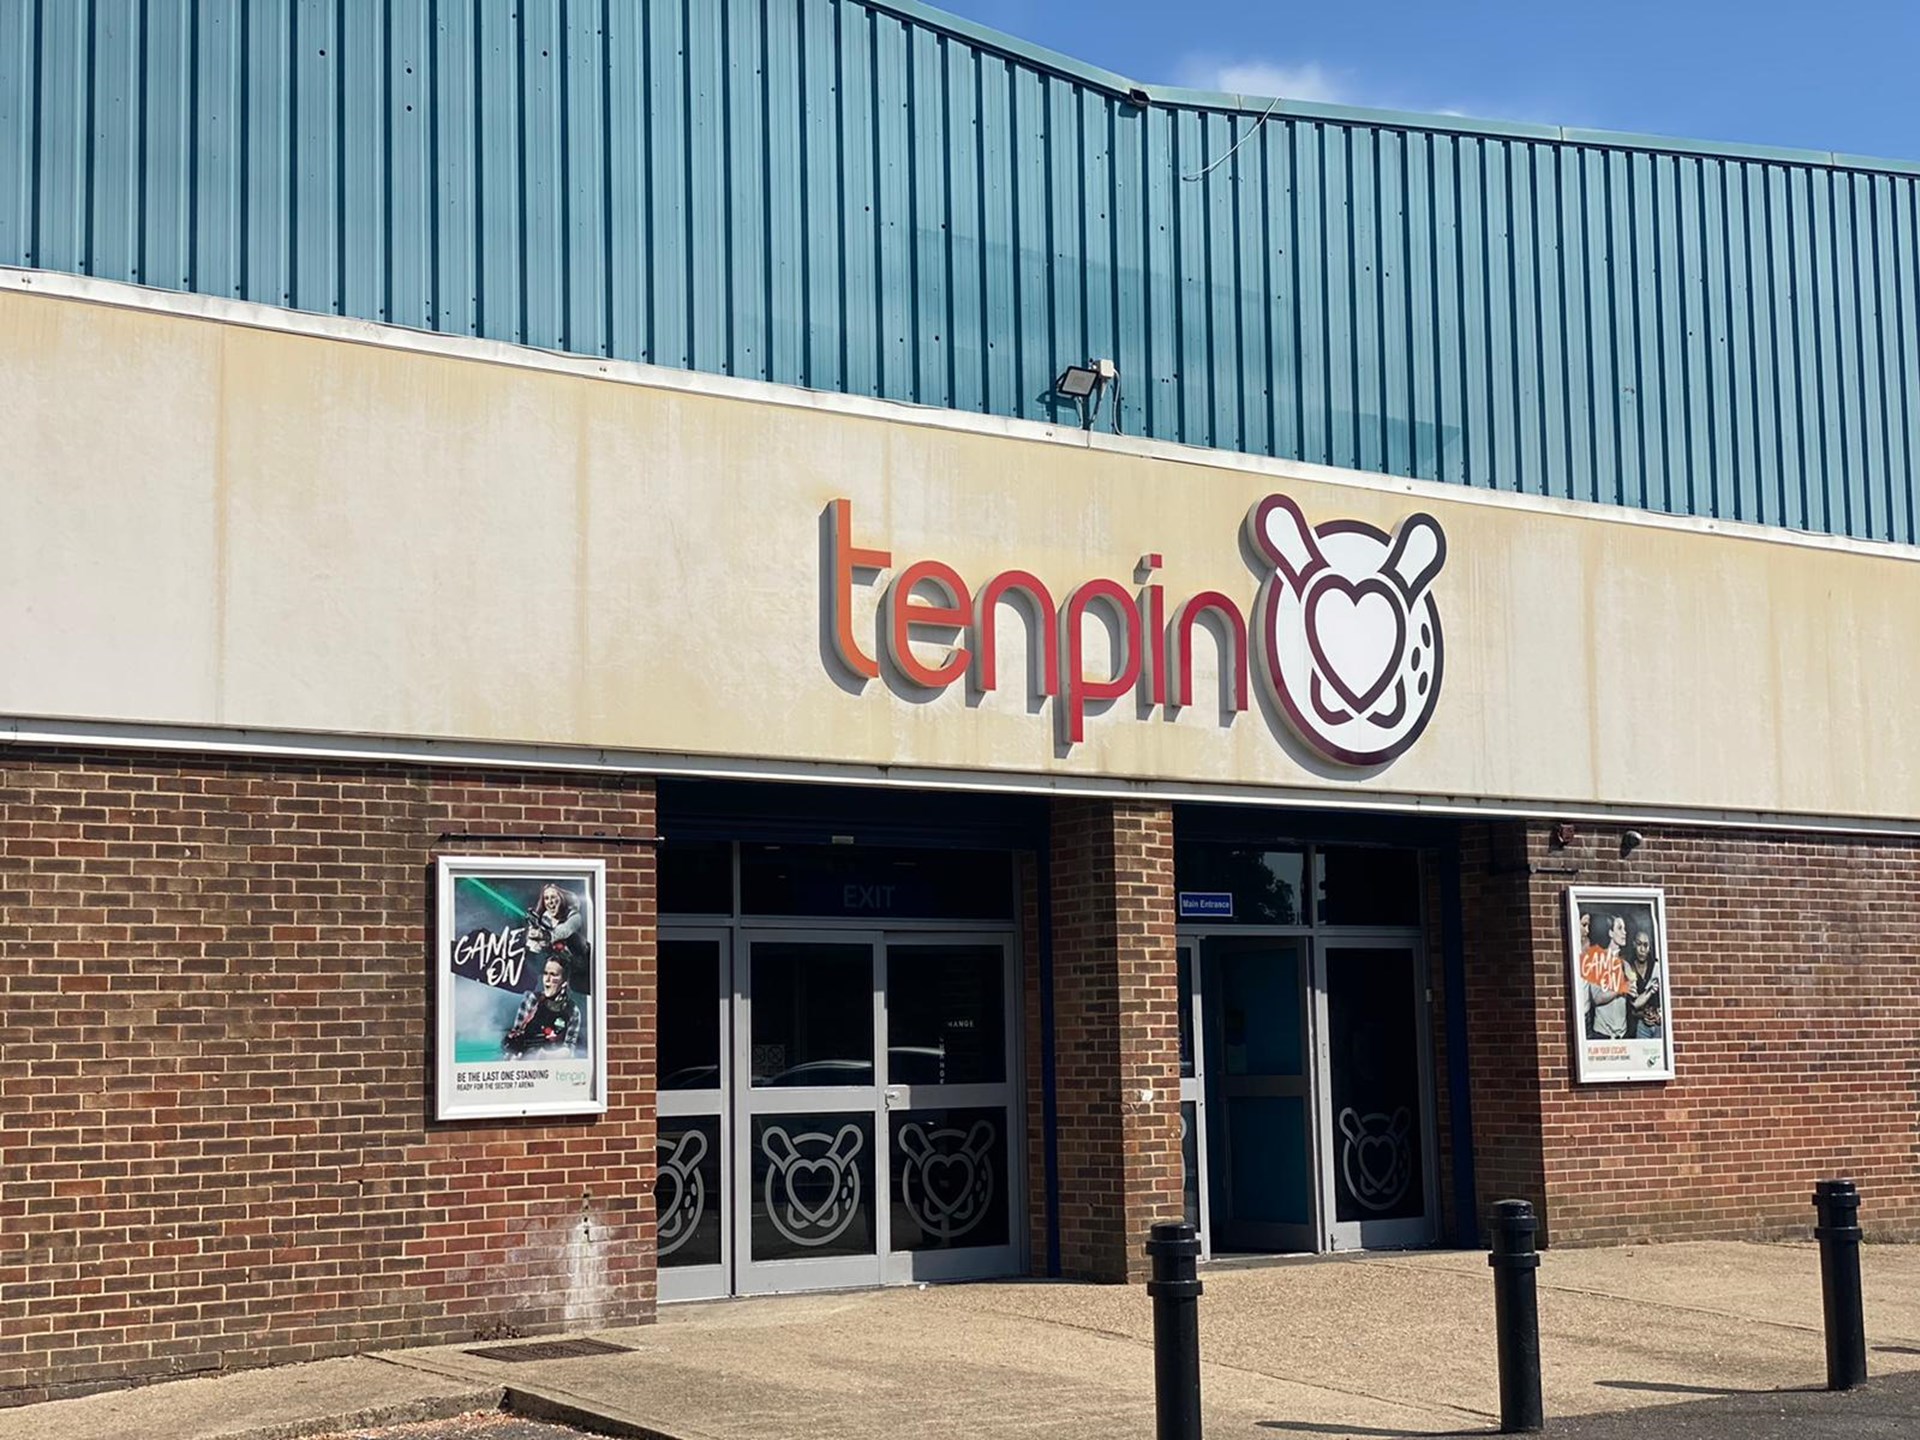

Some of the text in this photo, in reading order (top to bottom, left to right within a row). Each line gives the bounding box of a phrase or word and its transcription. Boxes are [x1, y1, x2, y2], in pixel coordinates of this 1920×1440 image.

[830, 498, 1249, 743] tenpin
[843, 884, 896, 909] EXIT
[1183, 899, 1229, 908] Main Entrance
[454, 925, 526, 970] GAME
[486, 957, 526, 986] ON
[1581, 947, 1622, 980] GAME
[1600, 970, 1622, 993] ON
[457, 1069, 549, 1082] BE THE LAST ONE STANDING
[484, 1082, 493, 1090] THE
